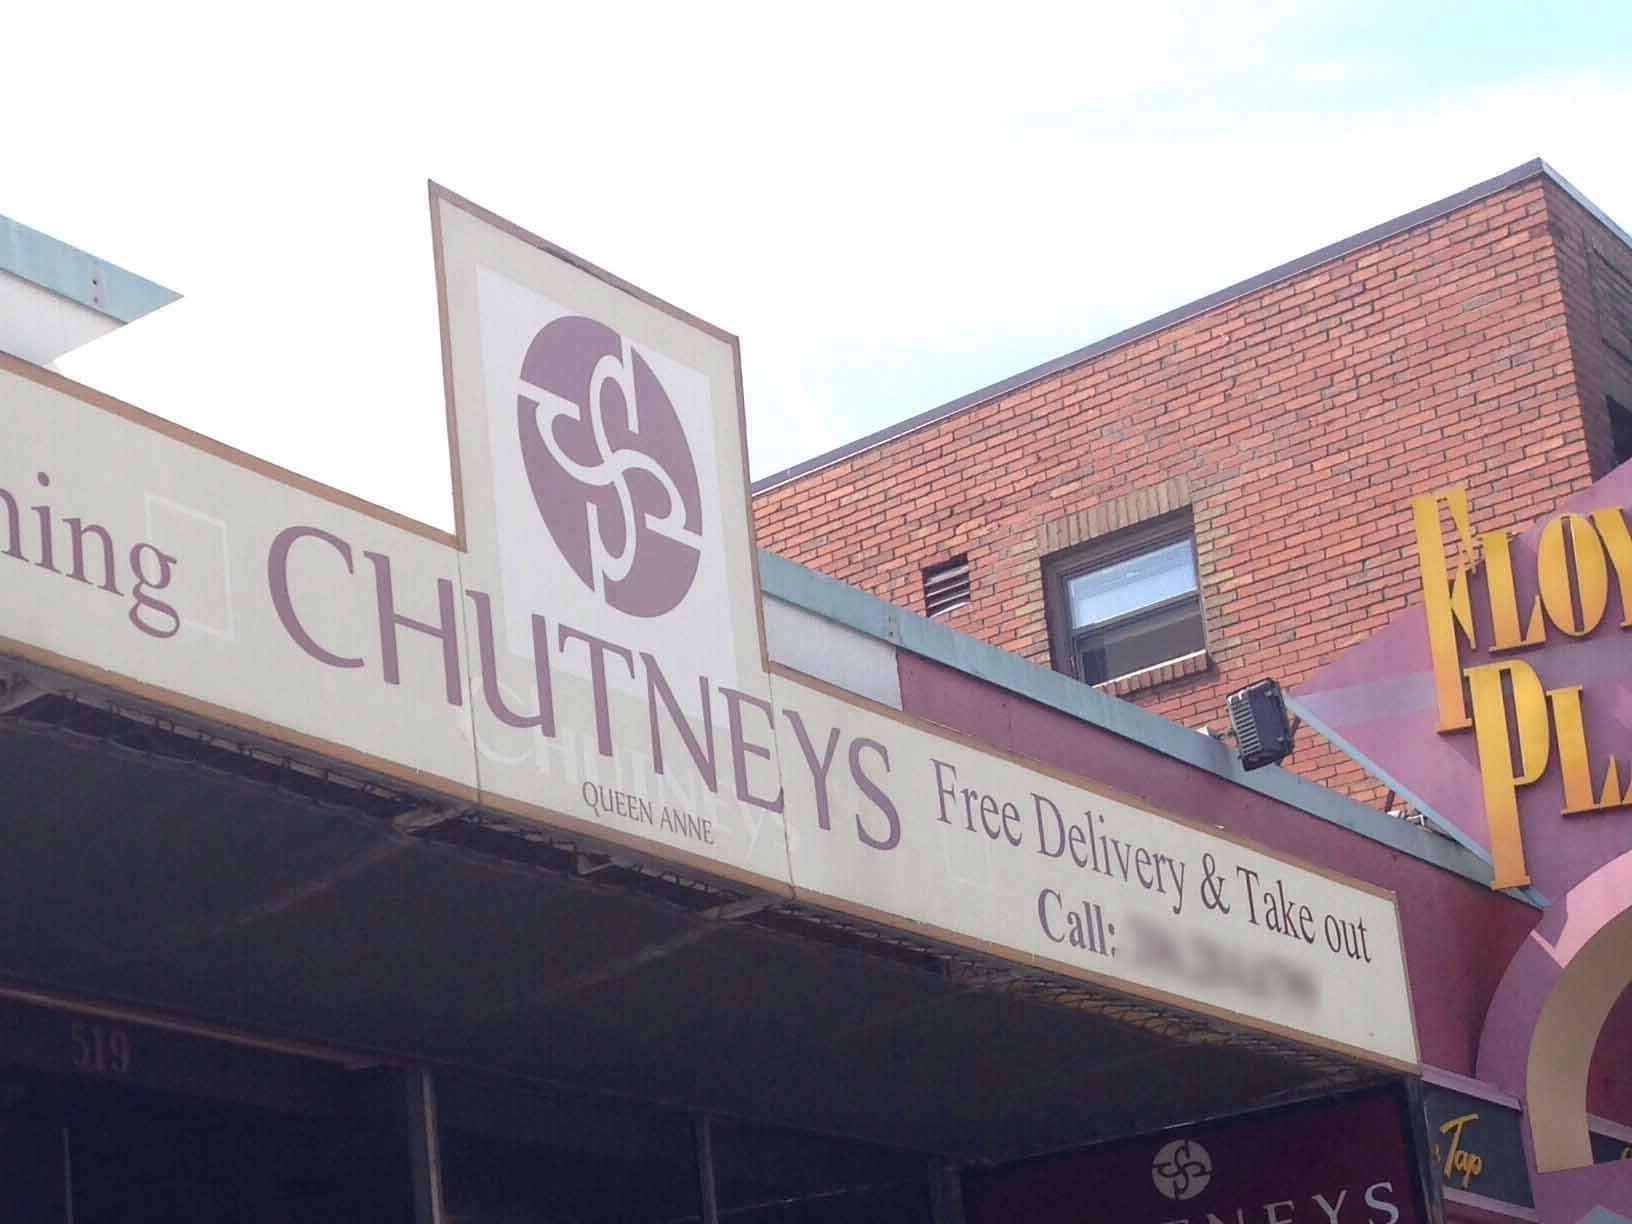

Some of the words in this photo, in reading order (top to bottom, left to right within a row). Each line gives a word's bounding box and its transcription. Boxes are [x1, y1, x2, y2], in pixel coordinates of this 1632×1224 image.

[268, 525, 901, 851] CHUTNEYS
[582, 781, 653, 824] QUEEN
[660, 806, 714, 845] ANNE
[1464, 659, 1632, 892] PL
[930, 758, 1022, 847] Free
[1030, 792, 1185, 914] Delivery
[1200, 853, 1231, 914] &
[1236, 866, 1314, 945] Take
[1325, 912, 1372, 963] out
[1038, 888, 1118, 957] Call:
[1439, 1113, 1482, 1188] Tap
